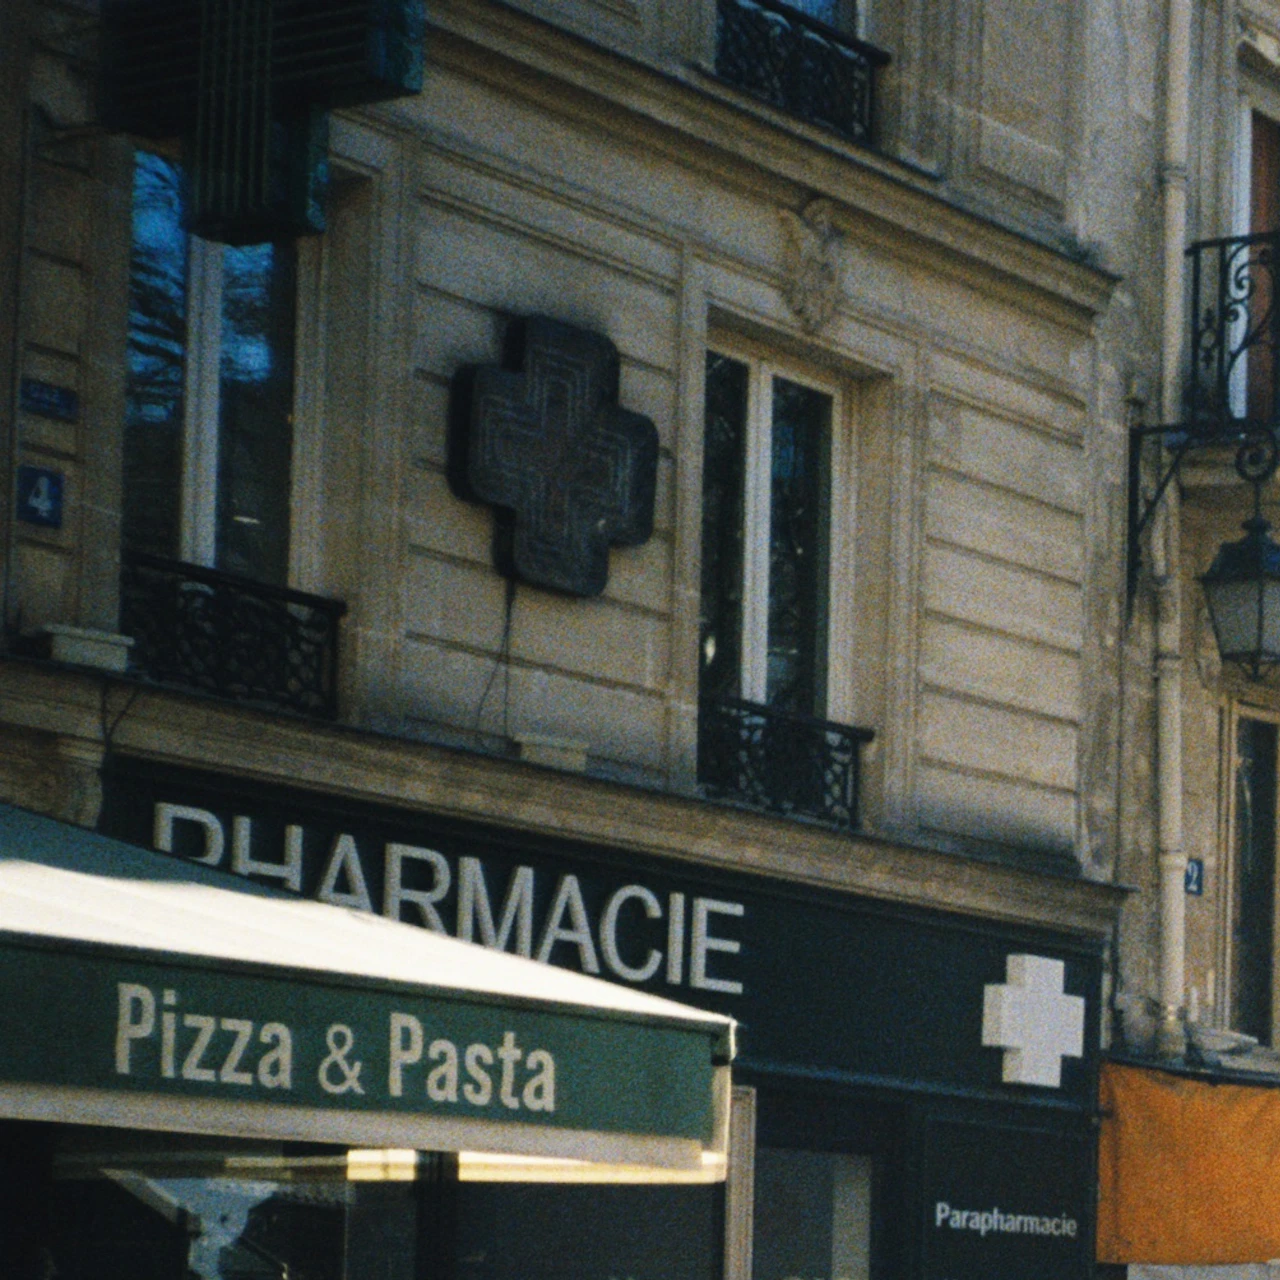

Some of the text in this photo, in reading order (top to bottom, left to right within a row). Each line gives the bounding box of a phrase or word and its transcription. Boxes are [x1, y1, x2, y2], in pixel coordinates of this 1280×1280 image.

[28, 476, 51, 516] 4
[154, 802, 745, 994] PHARMACIE
[115, 983, 556, 1112] Pizza & Pasta
[936, 1202, 1077, 1239] Parapharmacie
